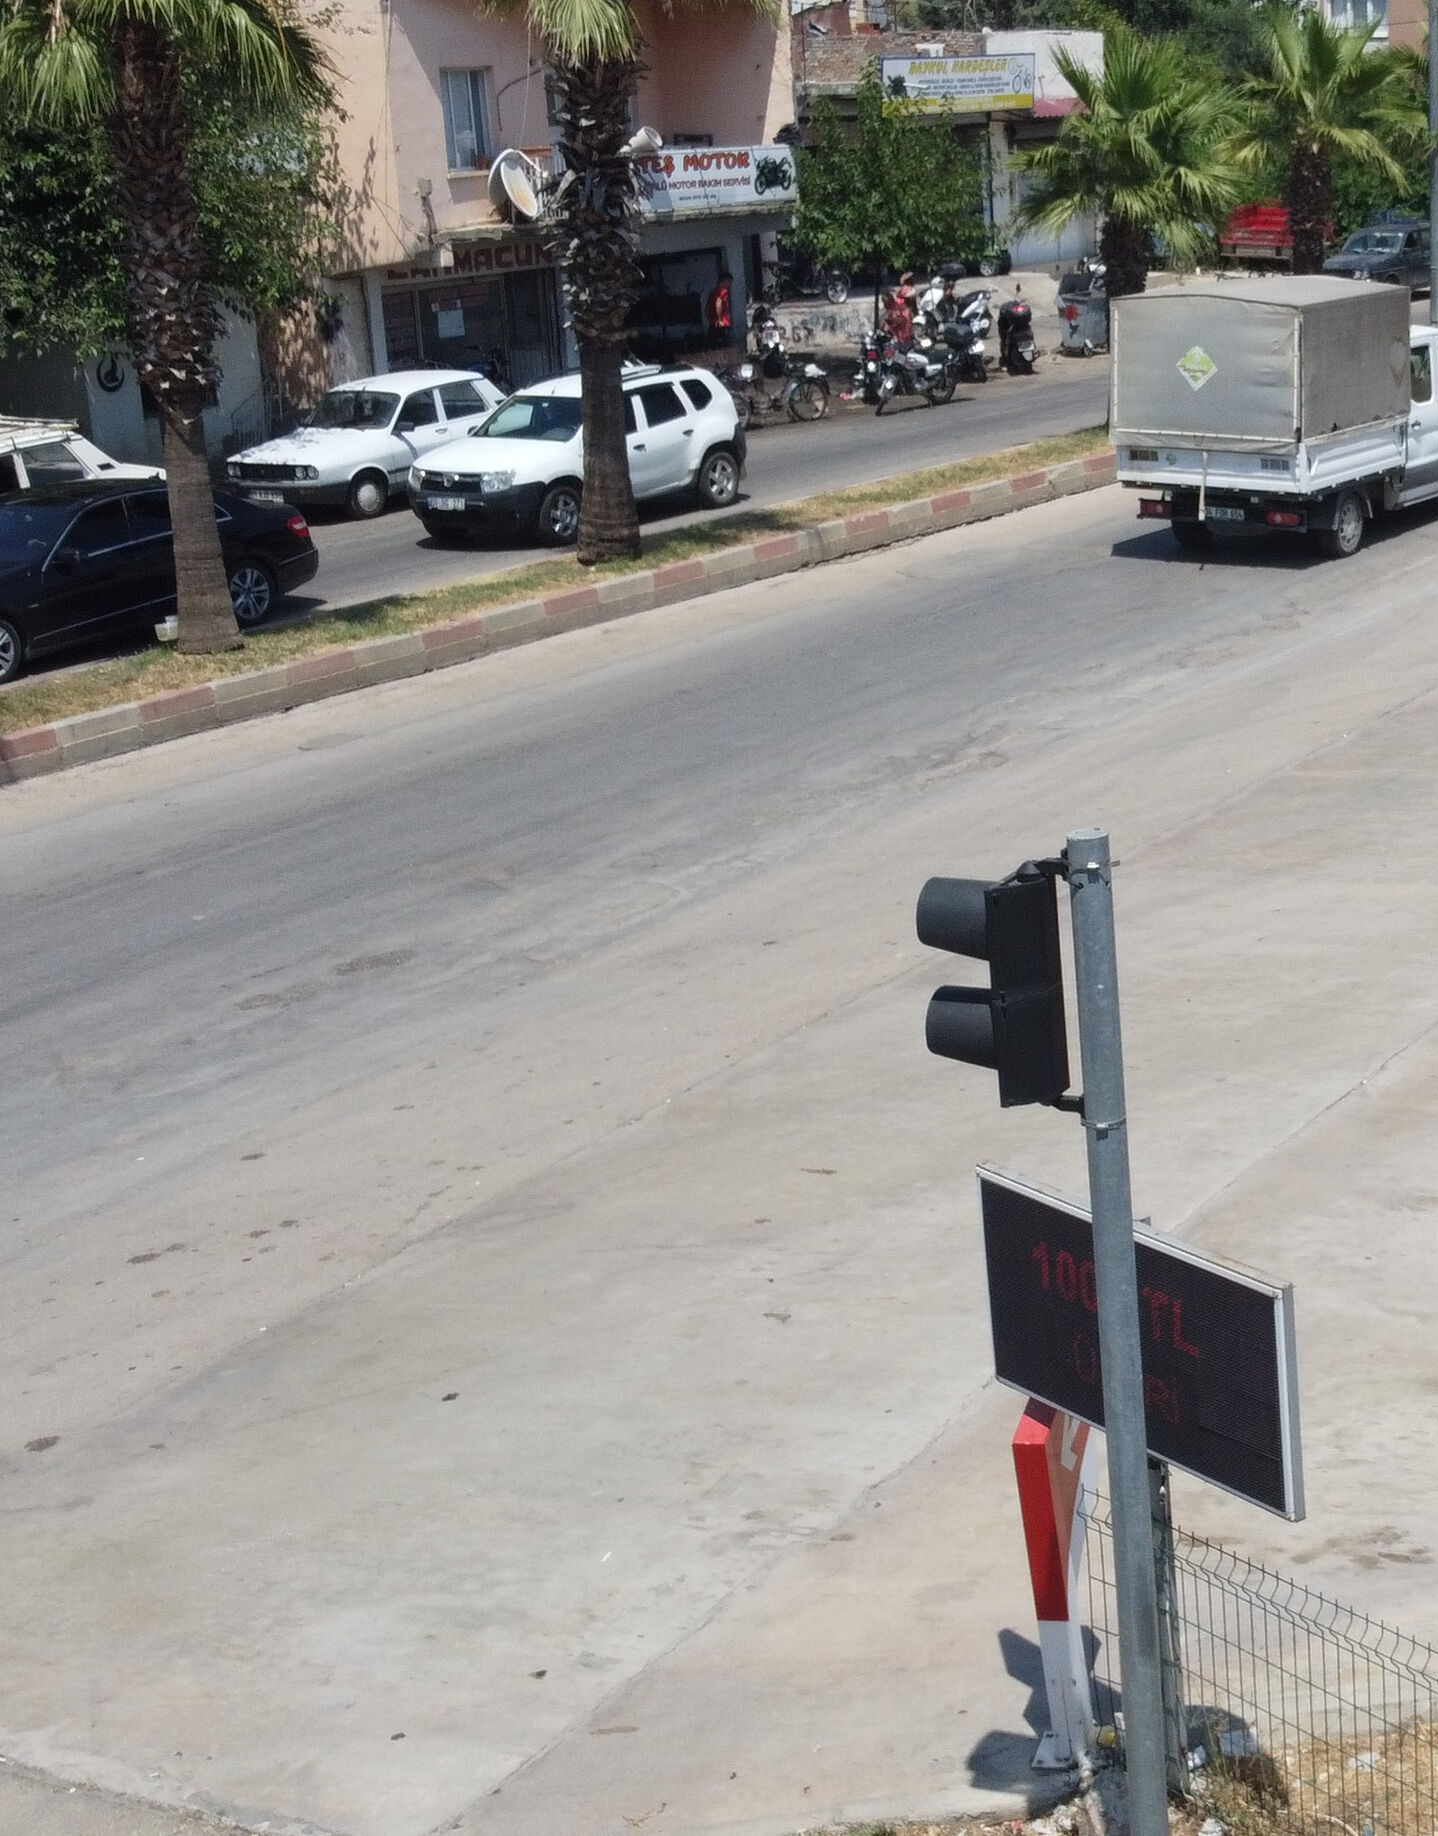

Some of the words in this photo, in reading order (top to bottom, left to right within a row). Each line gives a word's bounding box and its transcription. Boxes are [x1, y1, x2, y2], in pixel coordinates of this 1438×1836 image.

[637, 155, 675, 179] TEŞ
[683, 151, 750, 172] MOTOR
[668, 180, 697, 190] MOTOR
[1142, 1286, 1200, 1358] TL
